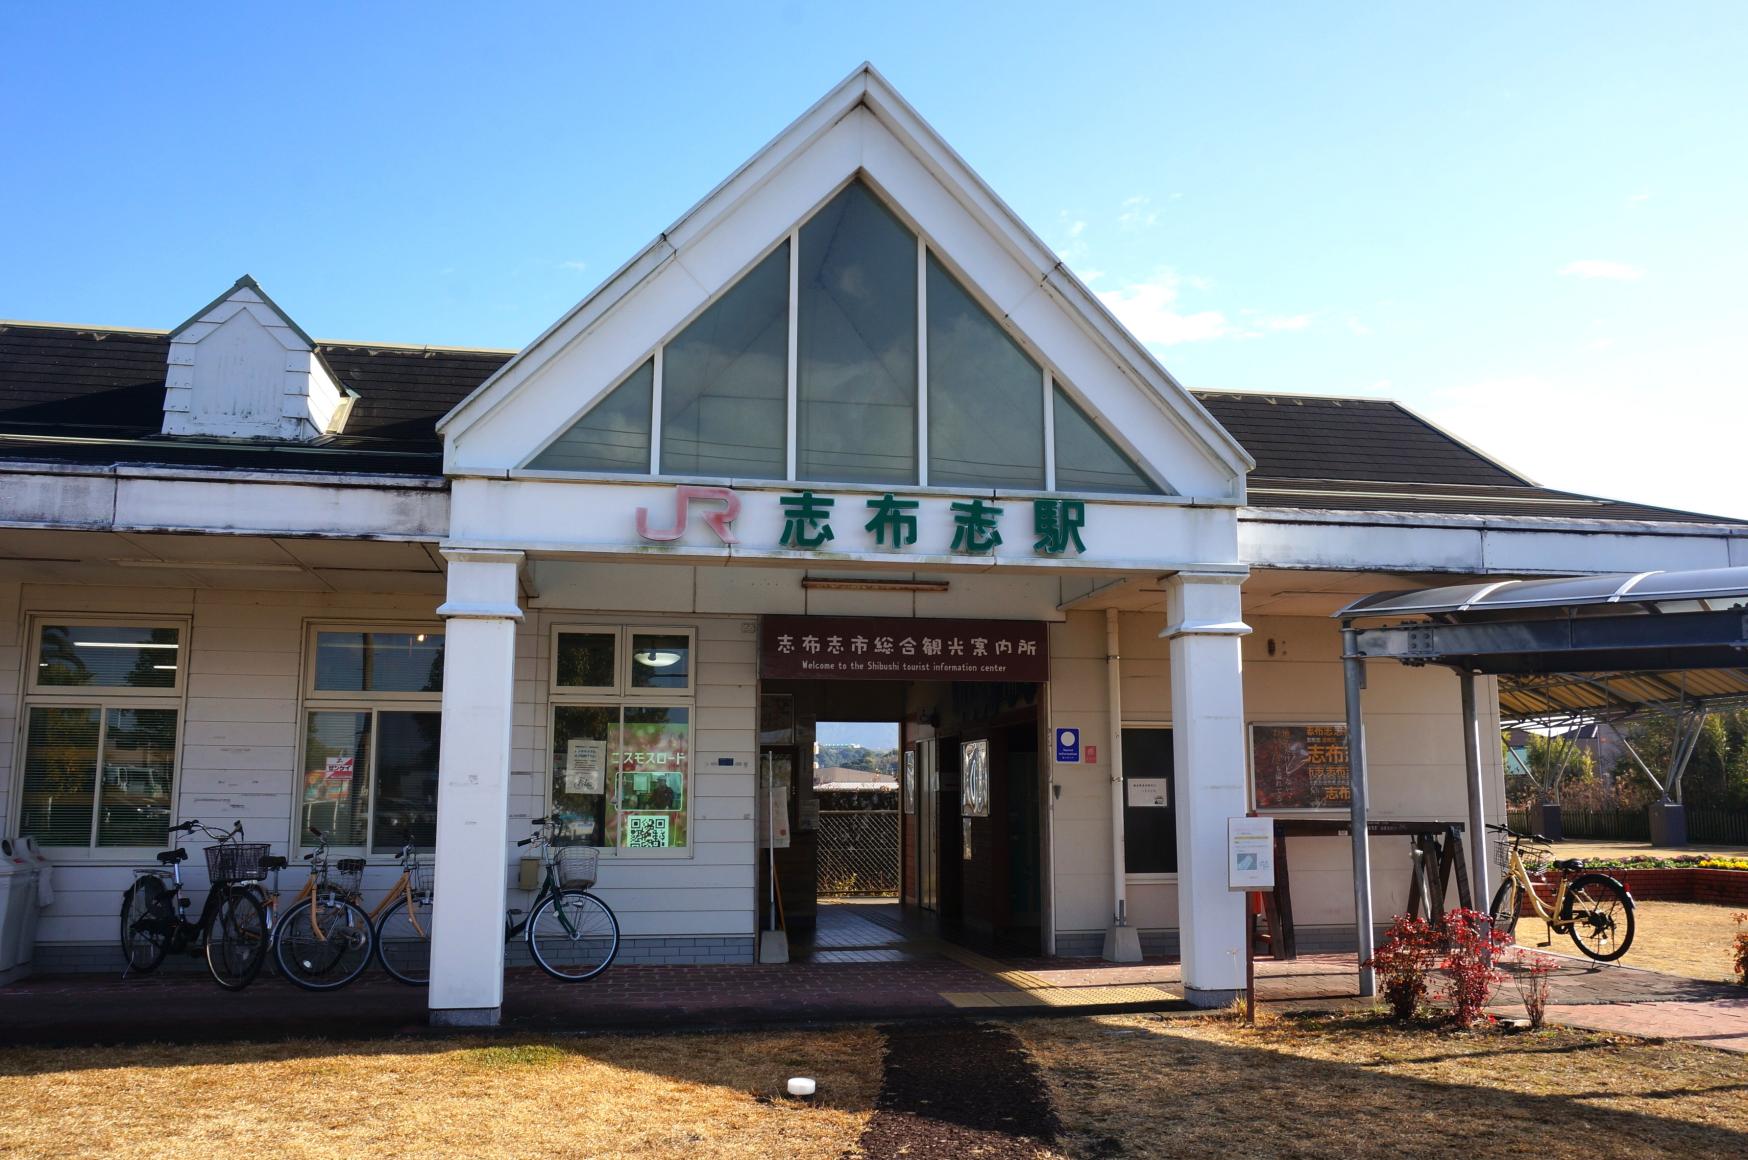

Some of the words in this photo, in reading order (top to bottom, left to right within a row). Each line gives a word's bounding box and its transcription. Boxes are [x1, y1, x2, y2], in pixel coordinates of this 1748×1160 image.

[636, 484, 742, 545] JR
[779, 489, 1087, 554] 志布志駅
[776, 633, 1037, 657] 志布志市総合観光案内所
[802, 659, 835, 670] Welcome
[838, 661, 847, 670] to
[850, 661, 864, 670] the
[867, 660, 900, 671] Shibushi
[902, 662, 931, 671] tourist
[933, 662, 977, 672] information
[980, 664, 1007, 672] center
[1307, 744, 1349, 764] 志布
